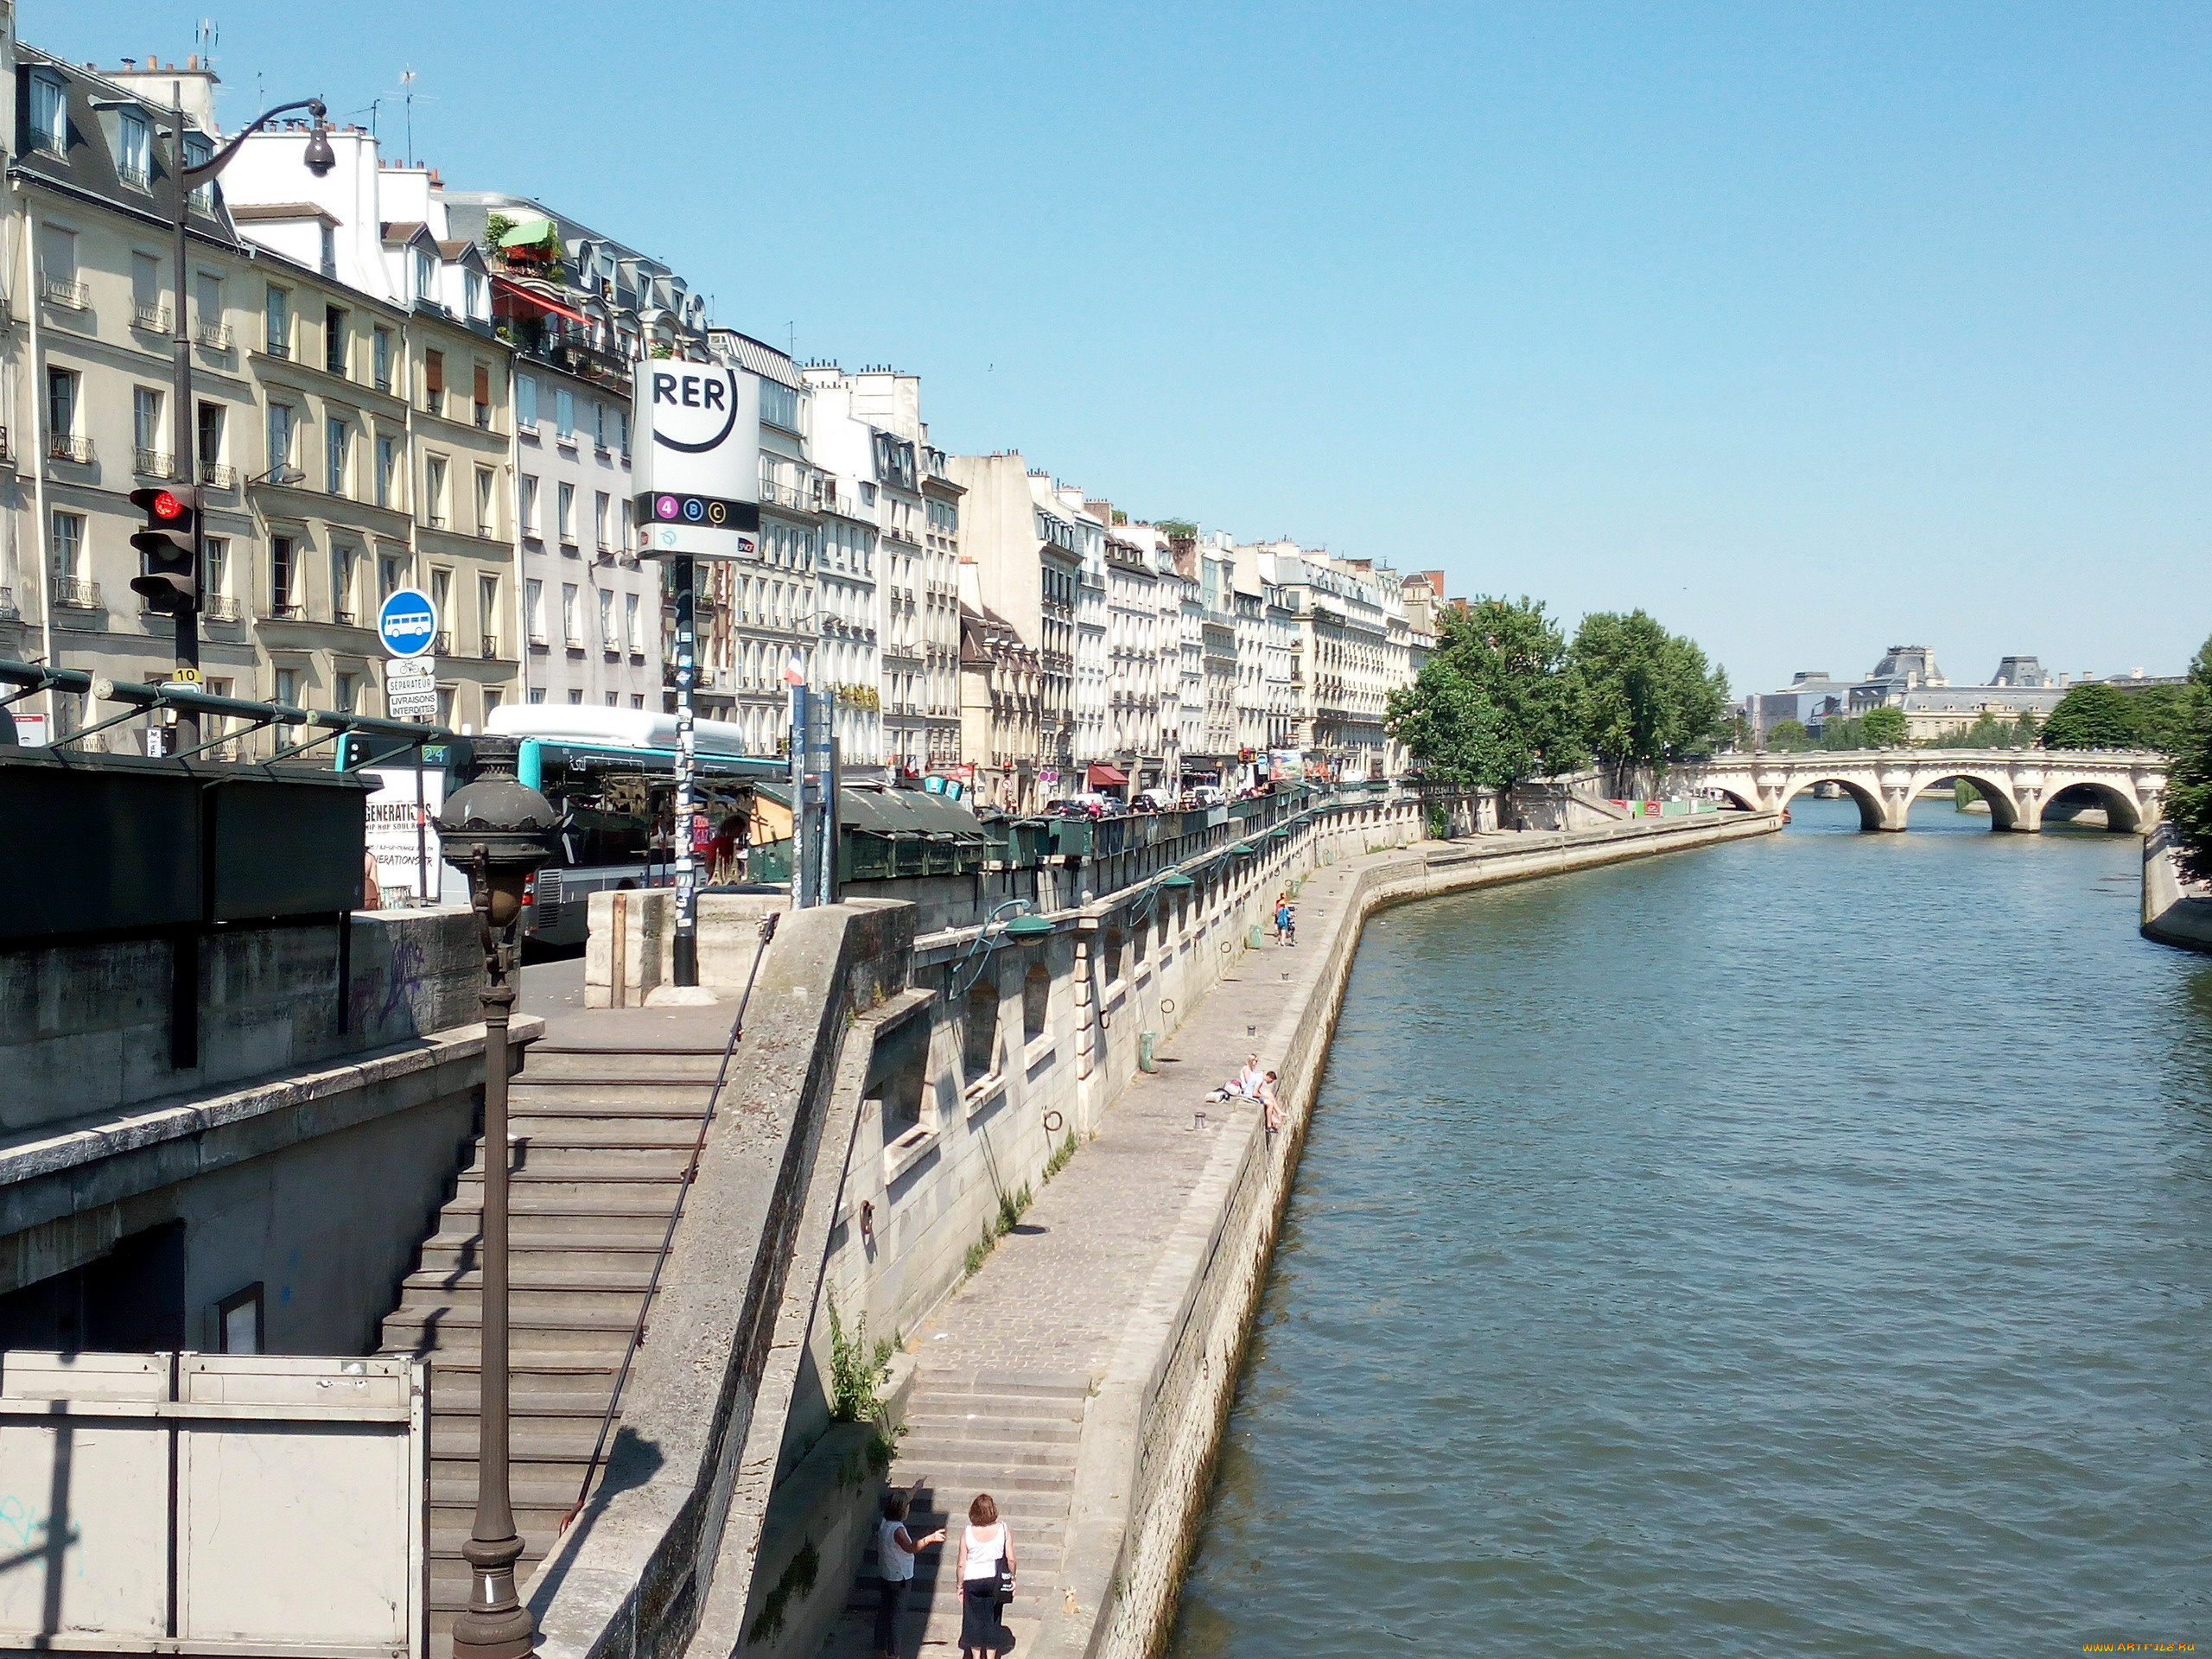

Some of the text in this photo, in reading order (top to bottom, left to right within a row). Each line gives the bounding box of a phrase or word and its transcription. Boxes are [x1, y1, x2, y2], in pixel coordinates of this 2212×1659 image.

[652, 372, 725, 411] RER
[661, 501, 721, 518] 4 B C
[738, 543, 753, 552] SNCF
[178, 671, 194, 681] 10
[391, 678, 430, 690] SÉPARATEUR
[391, 695, 435, 705] LIVRAISONS
[423, 748, 444, 762] 24
[365, 804, 431, 822] GENERATIOS
